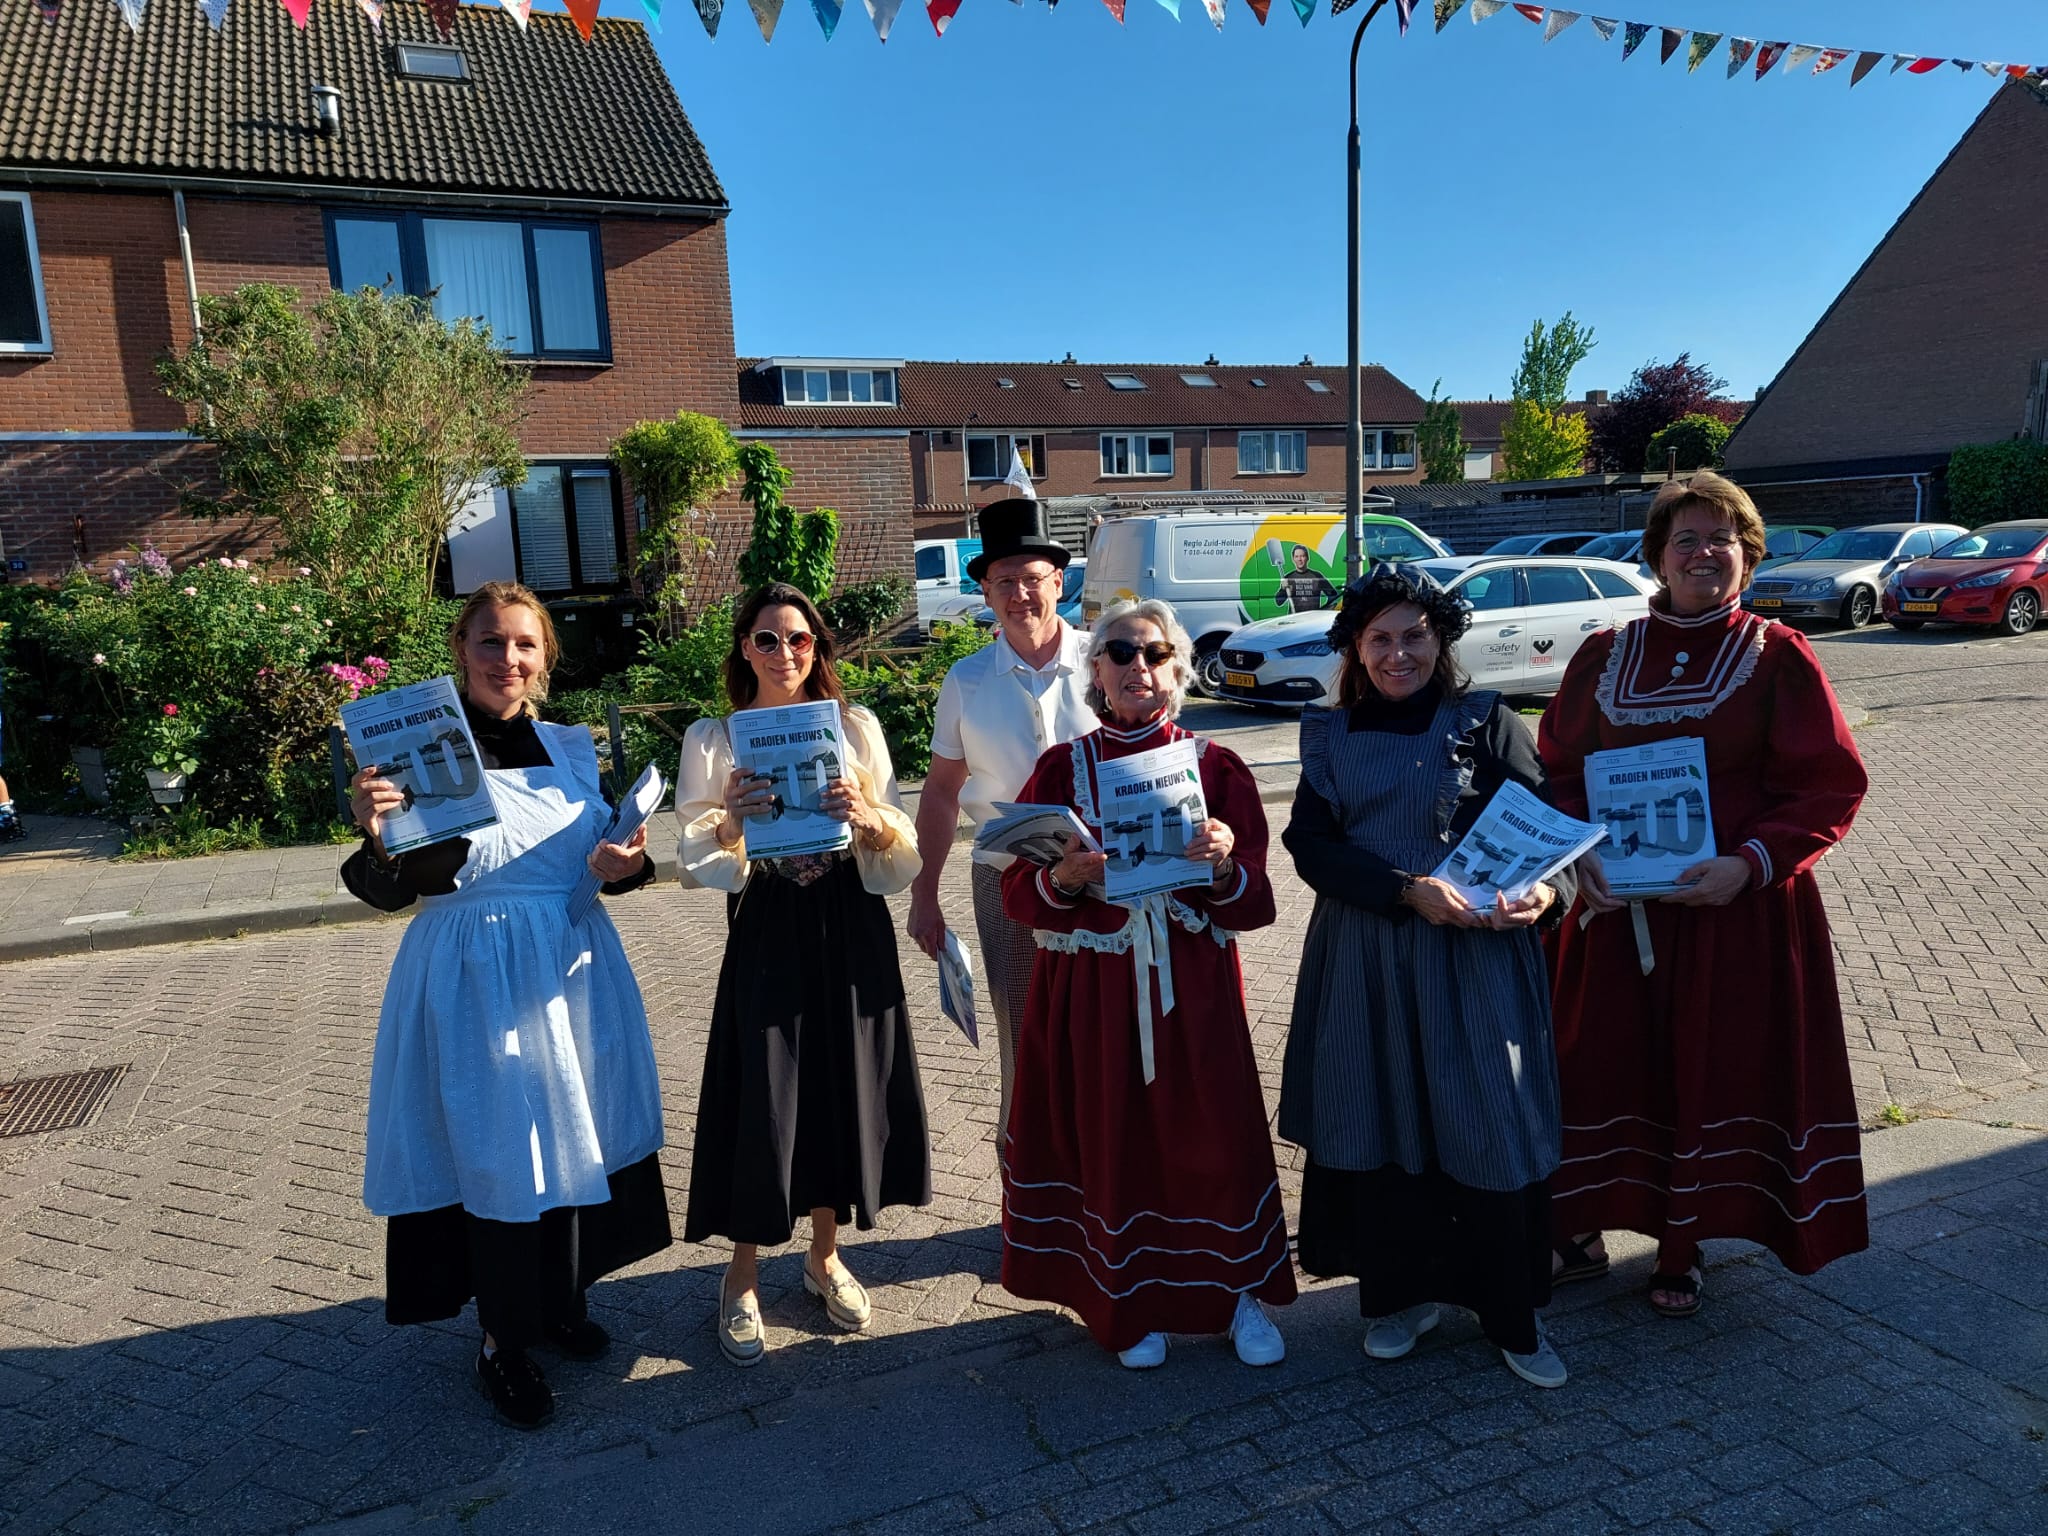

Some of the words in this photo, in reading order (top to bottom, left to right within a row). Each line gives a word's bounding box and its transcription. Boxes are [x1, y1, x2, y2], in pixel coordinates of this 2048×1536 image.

[1183, 539, 1203, 549] Regio
[1204, 539, 1247, 548] Zuid-Holland
[1488, 643, 1521, 653] safety
[361, 718, 404, 740] KRAOIEN
[404, 706, 444, 728] NIEUWS
[749, 734, 787, 749] KRAOIEN
[788, 729, 823, 745] NIEUWS
[1114, 780, 1153, 798] KRAOIEN
[1155, 770, 1186, 789] NIEUWS
[1608, 770, 1648, 785] KRAOIEN
[1650, 765, 1688, 781] NIEUWS
[1500, 809, 1540, 838] KRAOIEN
[1538, 831, 1574, 847] NIEUWS
